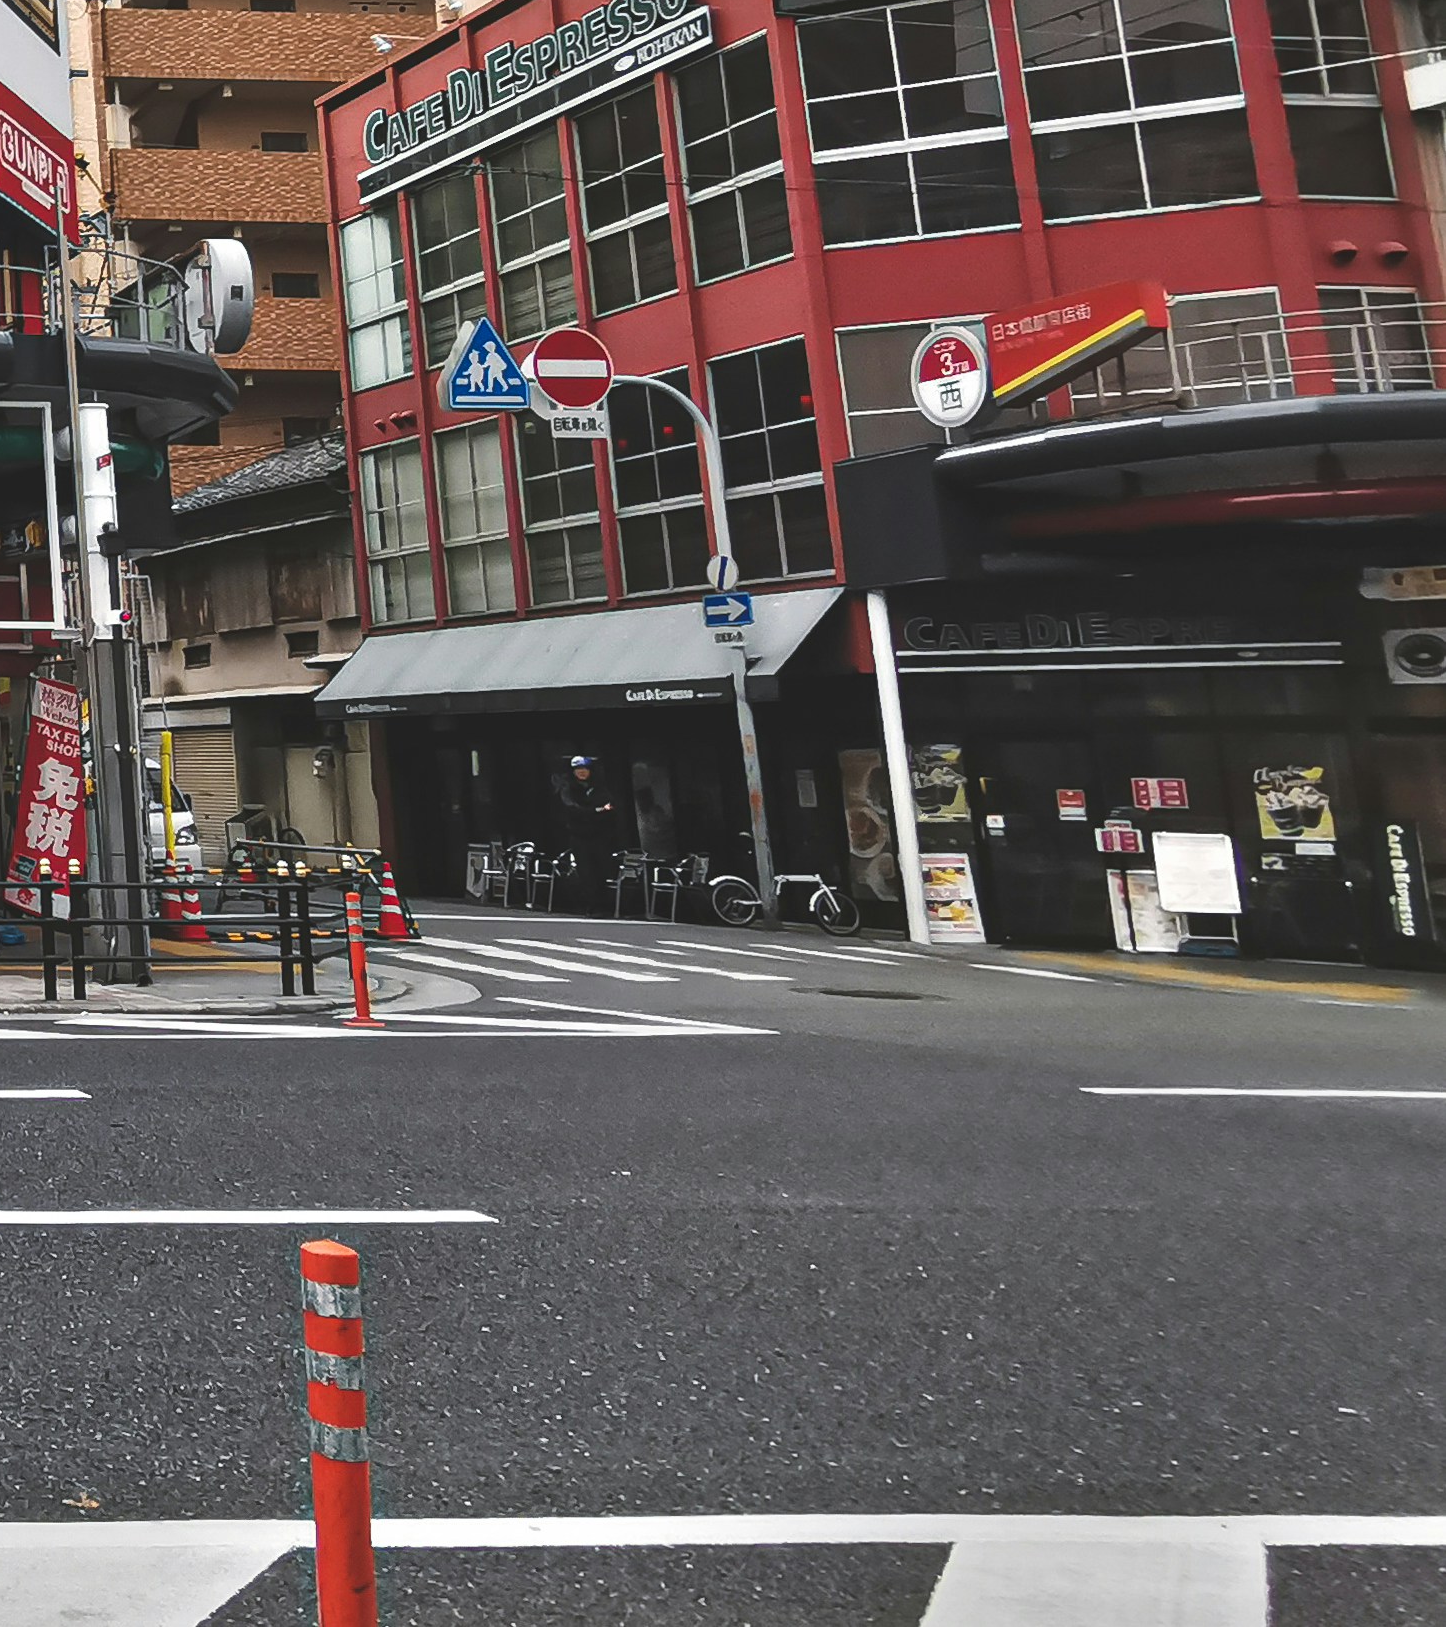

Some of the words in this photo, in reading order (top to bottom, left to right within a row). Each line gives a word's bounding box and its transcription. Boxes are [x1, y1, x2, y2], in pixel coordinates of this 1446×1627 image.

[362, 89, 447, 165] CAFE
[937, 379, 964, 412] 西
[40, 685, 81, 713] 热烈
[35, 721, 61, 741] TAX
[63, 731, 81, 747] FR
[23, 756, 81, 859] 免税
